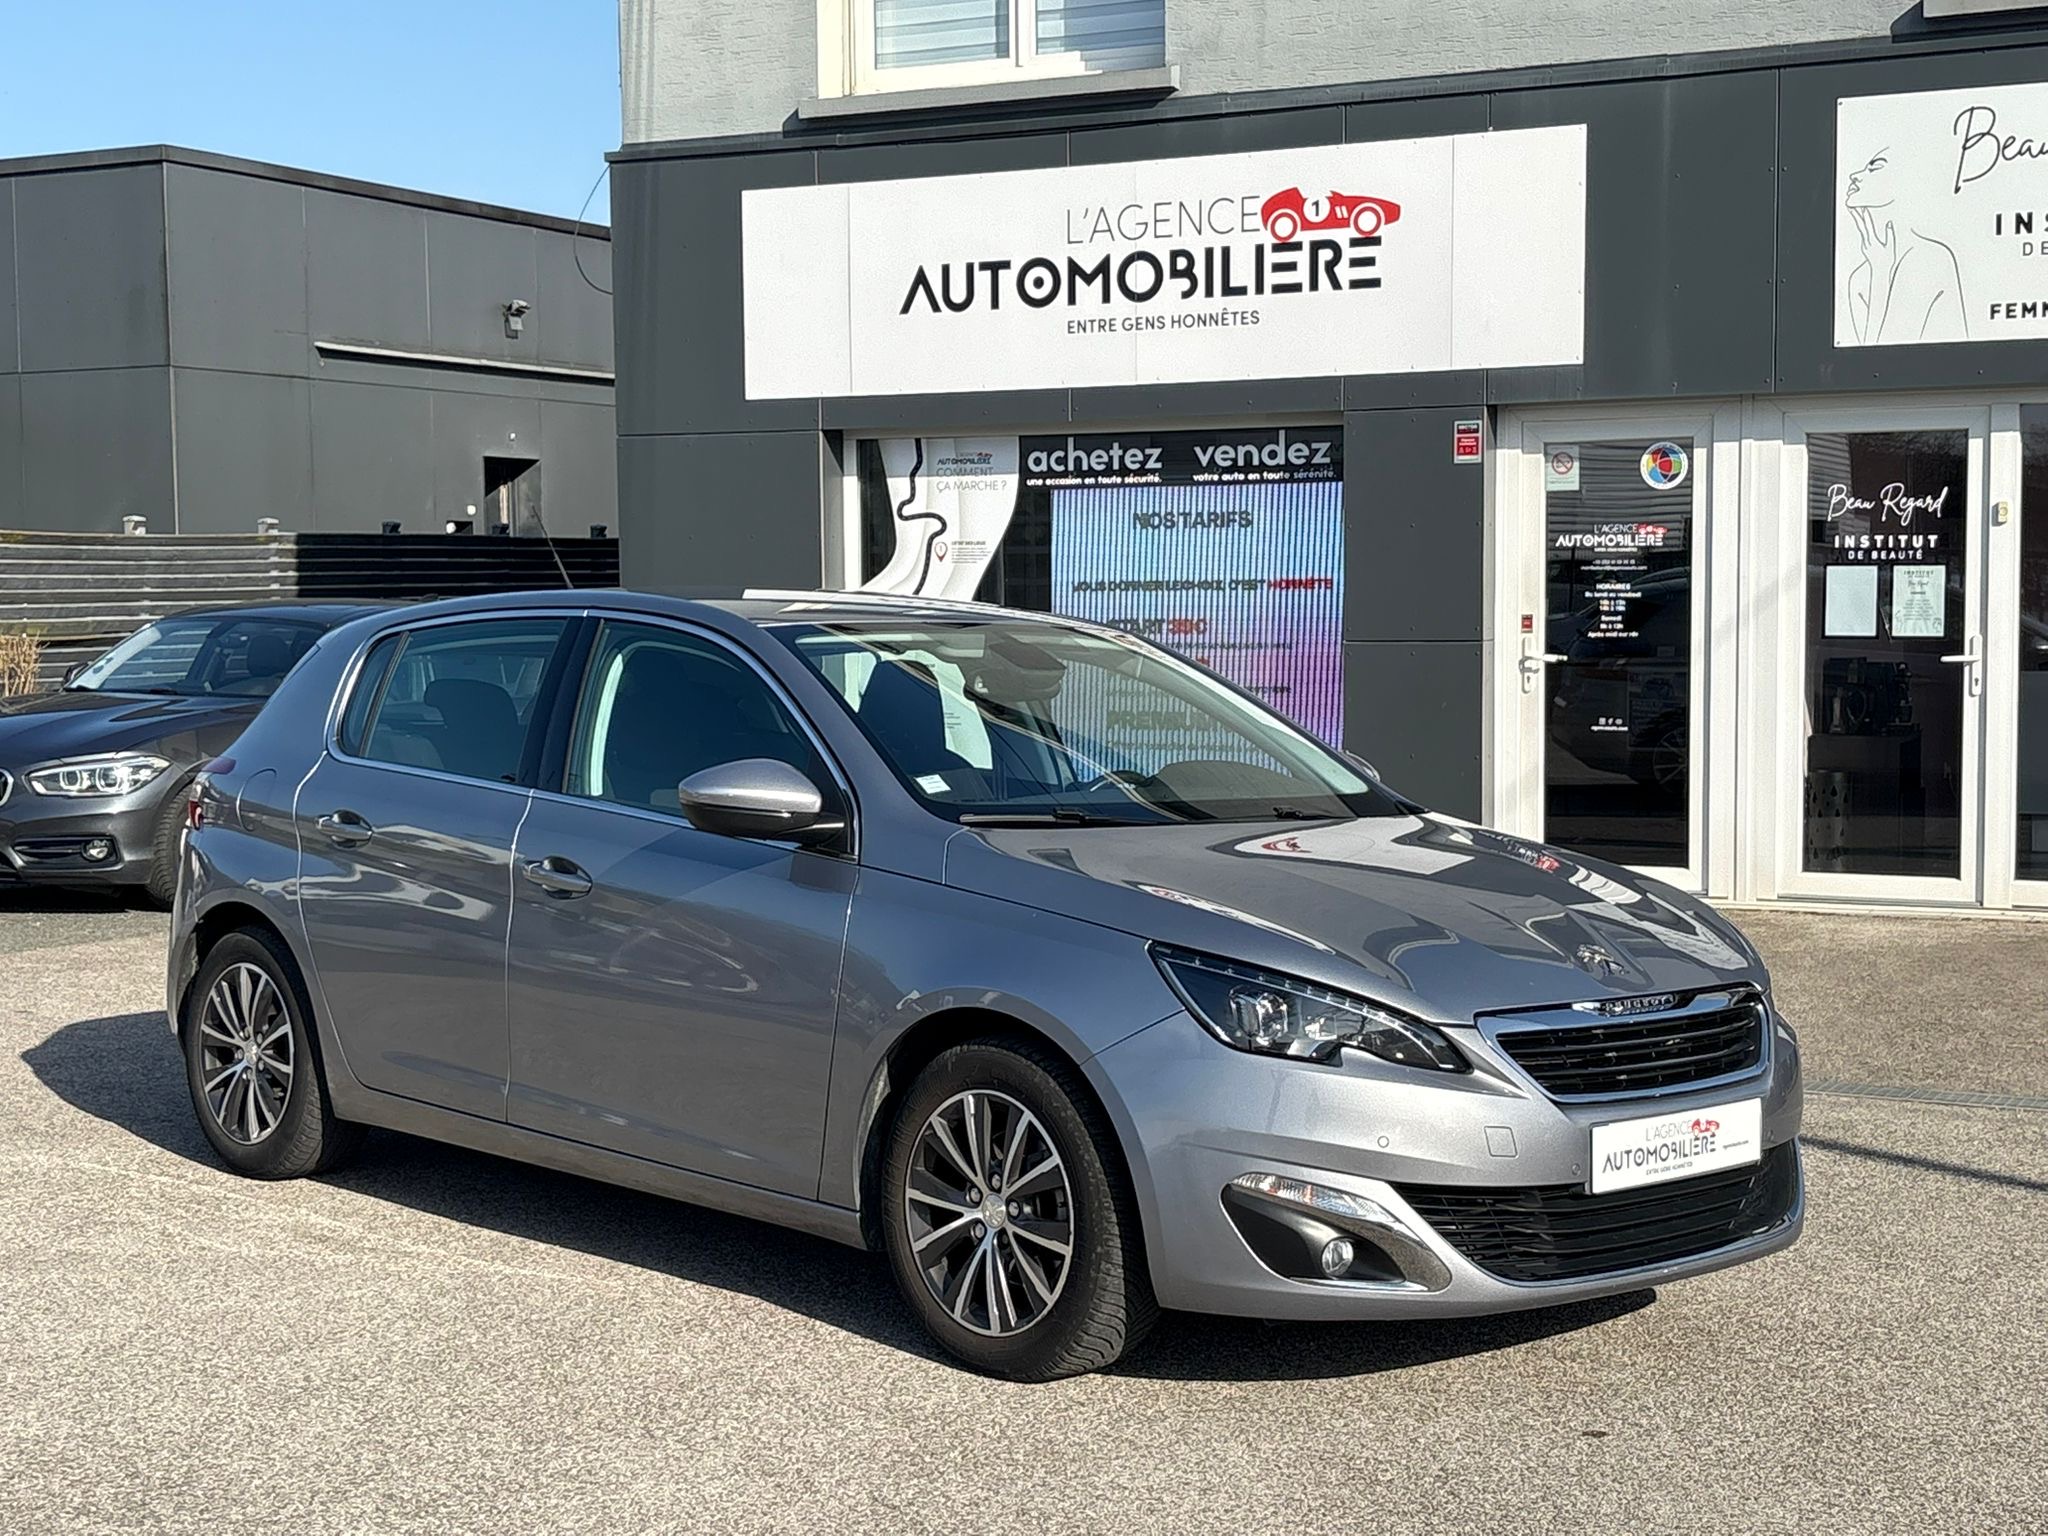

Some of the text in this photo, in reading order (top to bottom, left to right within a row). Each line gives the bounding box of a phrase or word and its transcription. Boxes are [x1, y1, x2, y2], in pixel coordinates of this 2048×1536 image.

[1310, 199, 1321, 217] 1
[1066, 194, 1261, 245] L'AGENCE
[1994, 211, 2048, 236] IN
[1067, 307, 1261, 334] ENTRE GENS HONNÊTES
[1027, 436, 1163, 473] achetez
[1193, 429, 1332, 468] vendez
[936, 466, 994, 478] COMMENT
[1026, 477, 1043, 486] une
[1045, 474, 1082, 486] occasion
[1084, 477, 1096, 485] en
[1098, 474, 1122, 485] toute
[1192, 472, 1220, 482] votre
[1221, 471, 1245, 482] auto
[1247, 471, 1260, 481] en
[1262, 469, 1291, 481] toute
[953, 479, 1000, 492] MARCHE
[1827, 482, 1949, 527] Beau Regard
[1178, 509, 1253, 530] TARIFS
[1594, 523, 1638, 534] L'AGENCE
[1834, 534, 1939, 549] INSTITUT
[1847, 548, 1923, 560] DE BEAUTÉ
[1645, 1119, 1694, 1142] L'AGENCE
